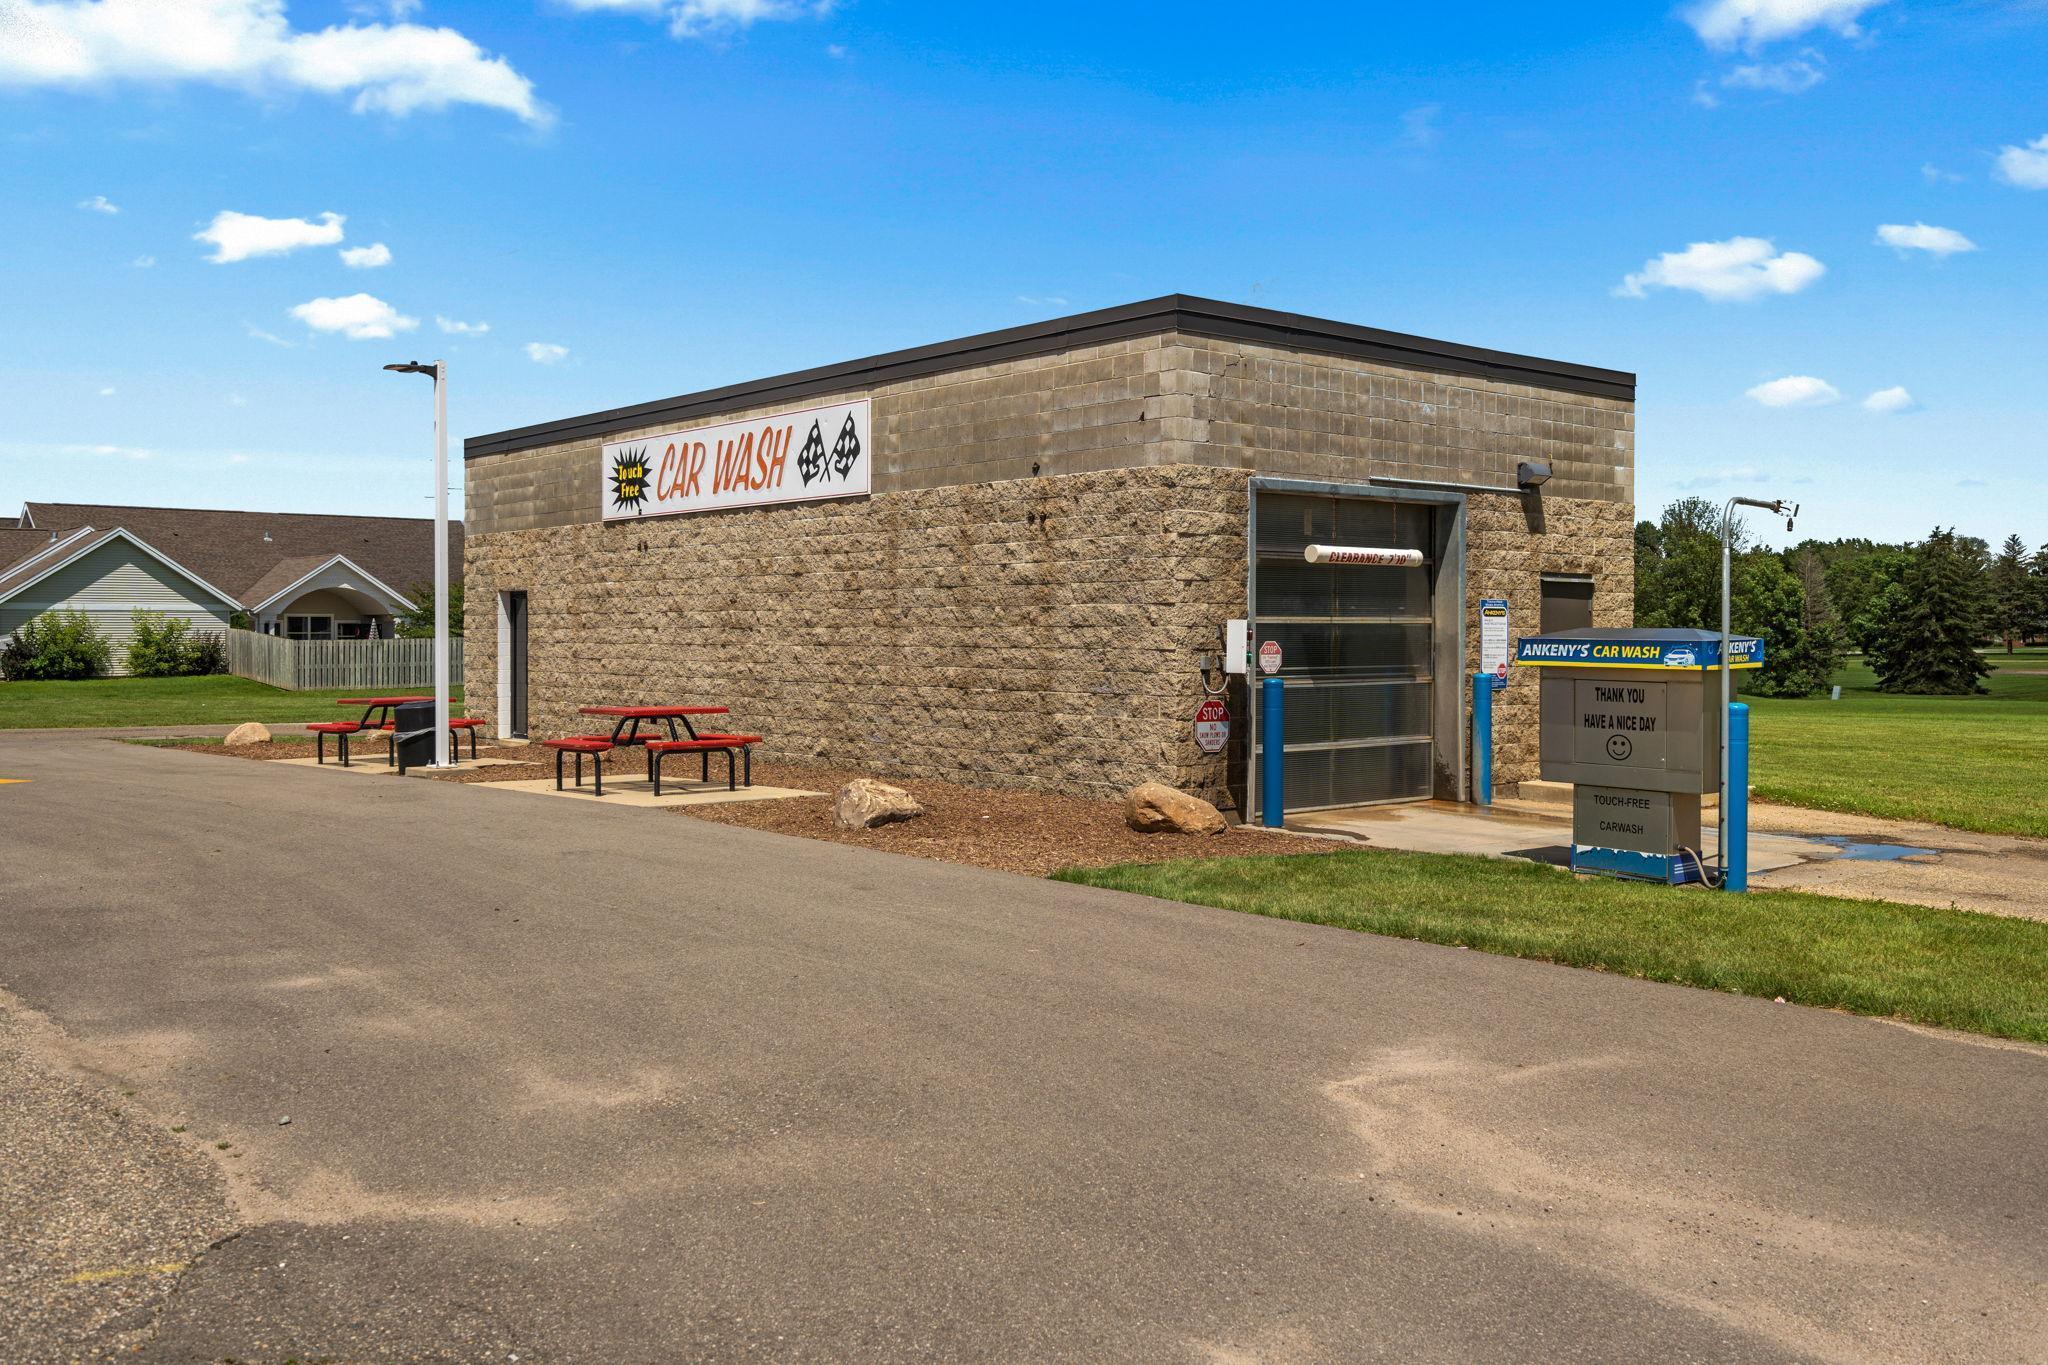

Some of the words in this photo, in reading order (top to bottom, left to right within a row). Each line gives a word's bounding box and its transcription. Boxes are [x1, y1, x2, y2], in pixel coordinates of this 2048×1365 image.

[618, 463, 642, 479] Touch
[657, 441, 706, 502] CAR
[712, 425, 792, 496] WASH
[621, 483, 640, 498] Free
[1328, 551, 1384, 564] CLEARANCE
[1264, 645, 1277, 654] STOP
[1521, 643, 1590, 658] ANKENY'S
[1593, 645, 1620, 658] CAR
[1621, 645, 1661, 659] WASH
[1717, 640, 1757, 655] AKENY'S
[1595, 686, 1624, 703] THANK
[1627, 688, 1645, 704] YOU
[1202, 707, 1224, 720] STOP
[1209, 723, 1217, 731] NO
[1584, 713, 1606, 729] HAVE
[1608, 715, 1614, 729] A
[1616, 716, 1637, 731] NICE
[1639, 716, 1657, 732] DAY
[1594, 795, 1650, 809] TOUCH-FREE
[1599, 821, 1643, 834] CARWASH
